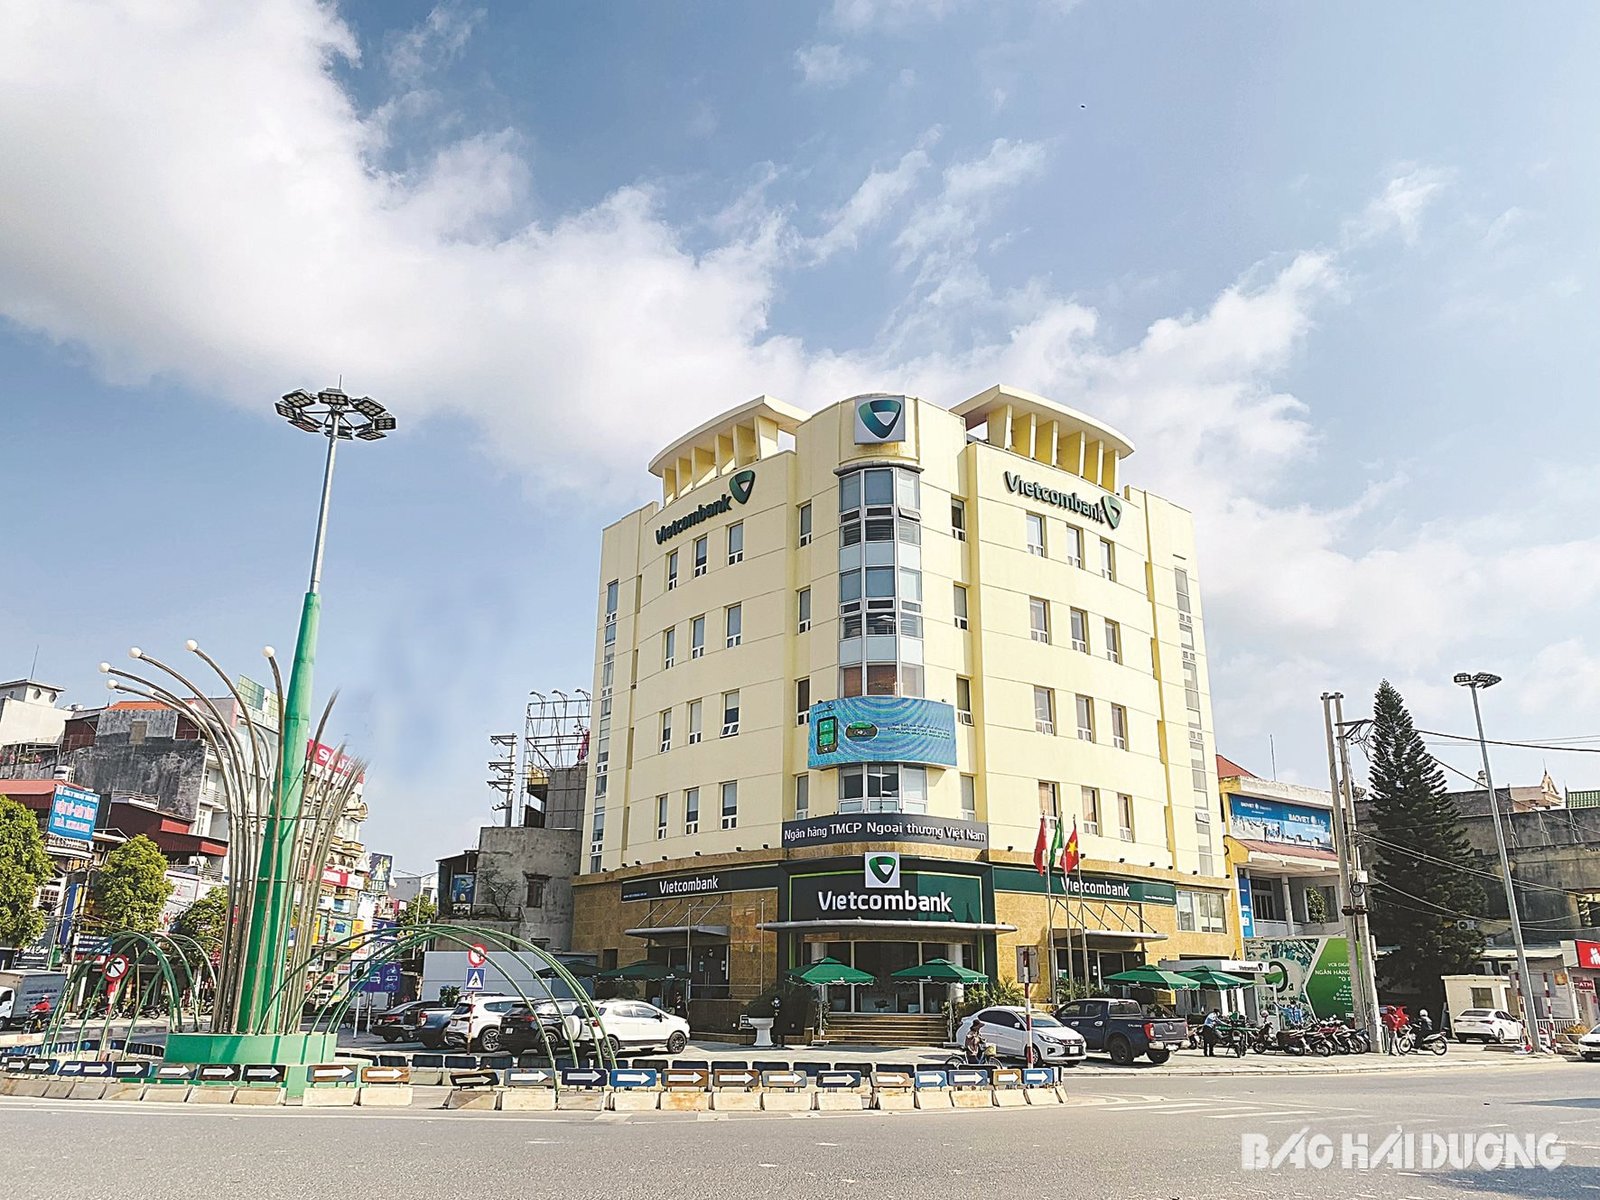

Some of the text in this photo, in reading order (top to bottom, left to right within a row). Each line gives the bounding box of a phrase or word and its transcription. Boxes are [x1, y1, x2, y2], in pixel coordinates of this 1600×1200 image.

[1003, 471, 1105, 524] Vietcombank
[656, 494, 732, 545] Vietcombank
[784, 822, 986, 842] Ngân hàng TMCP Ngoại thương Việt Nam
[660, 875, 719, 894] Vietcombank
[1061, 876, 1131, 898] Vietcombank
[818, 890, 952, 913] Vietcombank
